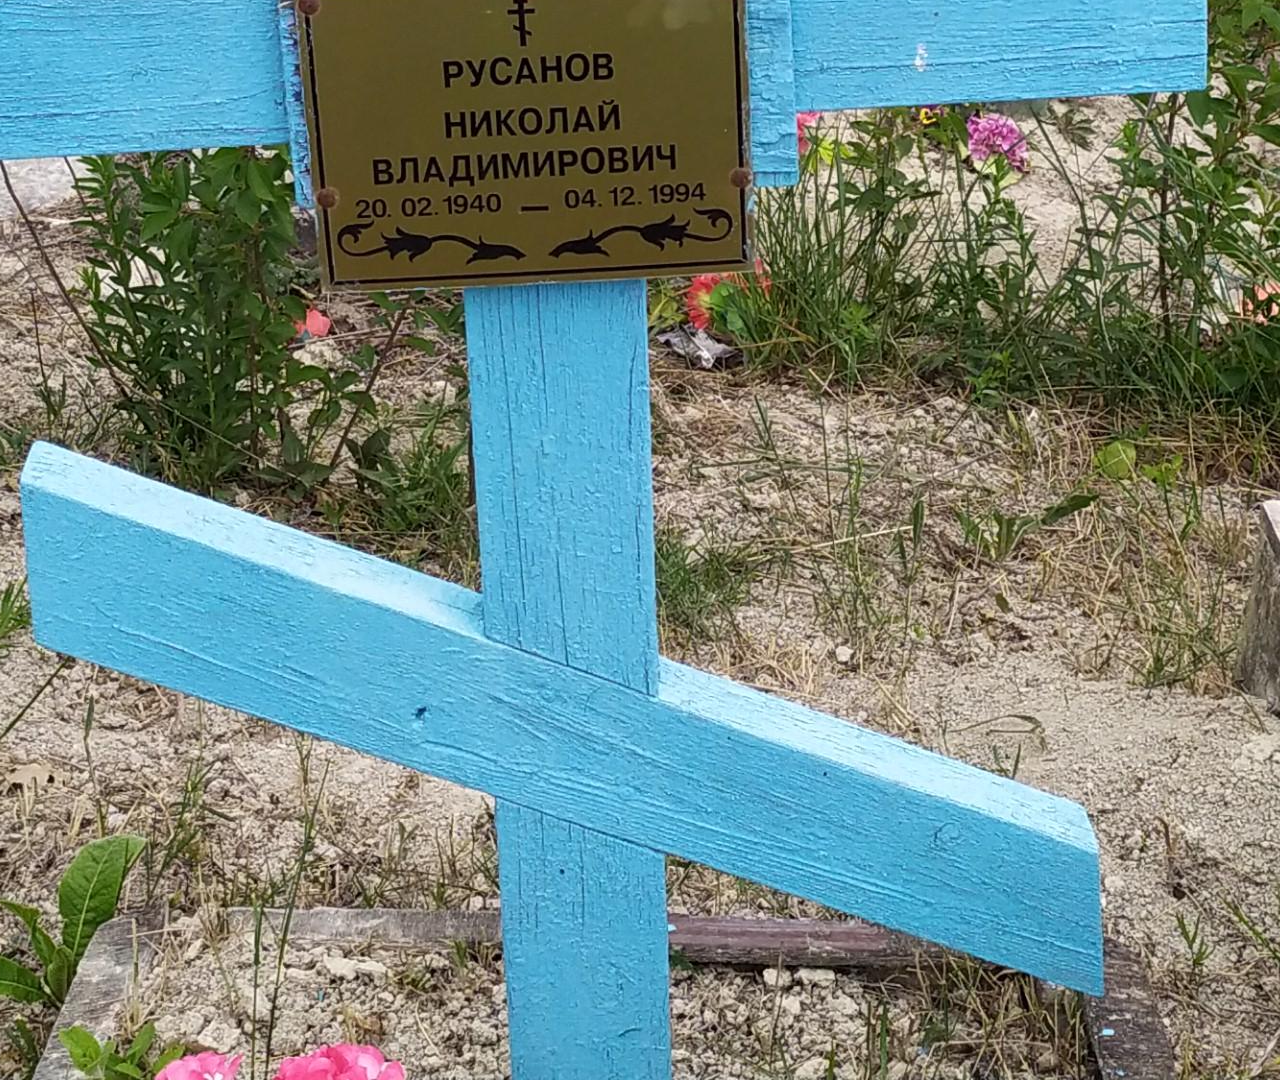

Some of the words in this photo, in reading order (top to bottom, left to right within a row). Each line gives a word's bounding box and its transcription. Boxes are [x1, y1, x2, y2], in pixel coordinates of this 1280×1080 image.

[441, 52, 615, 89] РУСАНОВ
[443, 99, 621, 139] НИКОЛАЙ
[371, 143, 678, 188] ВЛАДИМИРОВИЧ
